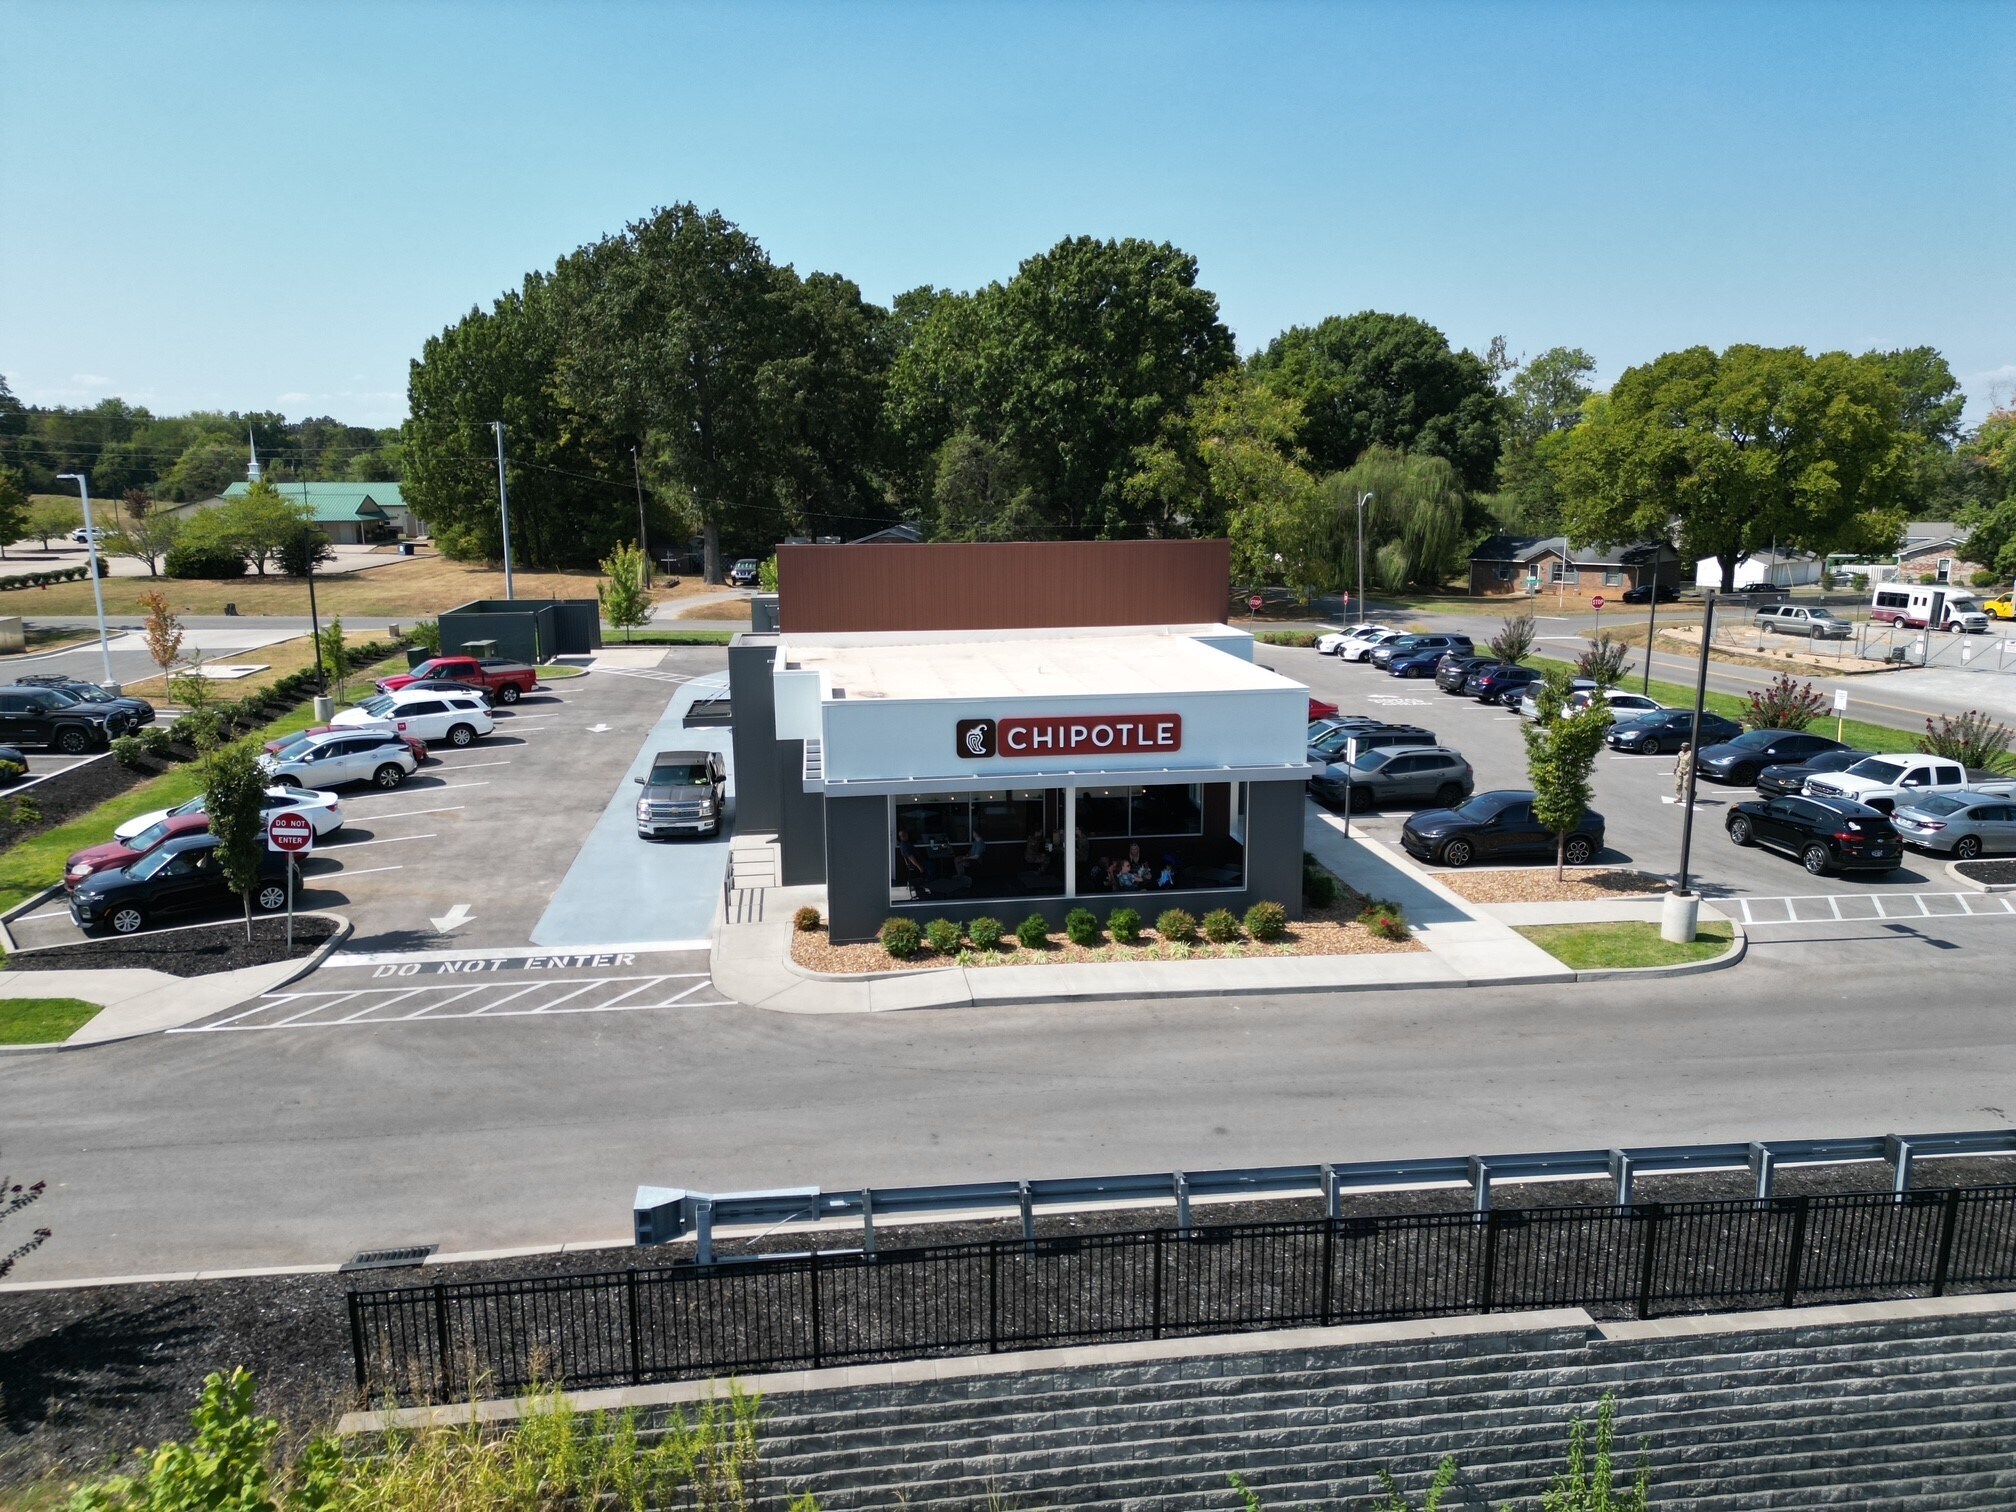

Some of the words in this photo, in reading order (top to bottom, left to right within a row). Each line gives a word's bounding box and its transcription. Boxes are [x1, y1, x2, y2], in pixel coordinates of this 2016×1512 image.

[1007, 722, 1174, 750] CHIPOTLE
[278, 836, 303, 844] ENTER
[371, 963, 422, 978] DO
[436, 959, 508, 975] NOT
[523, 953, 637, 971] ENTER
